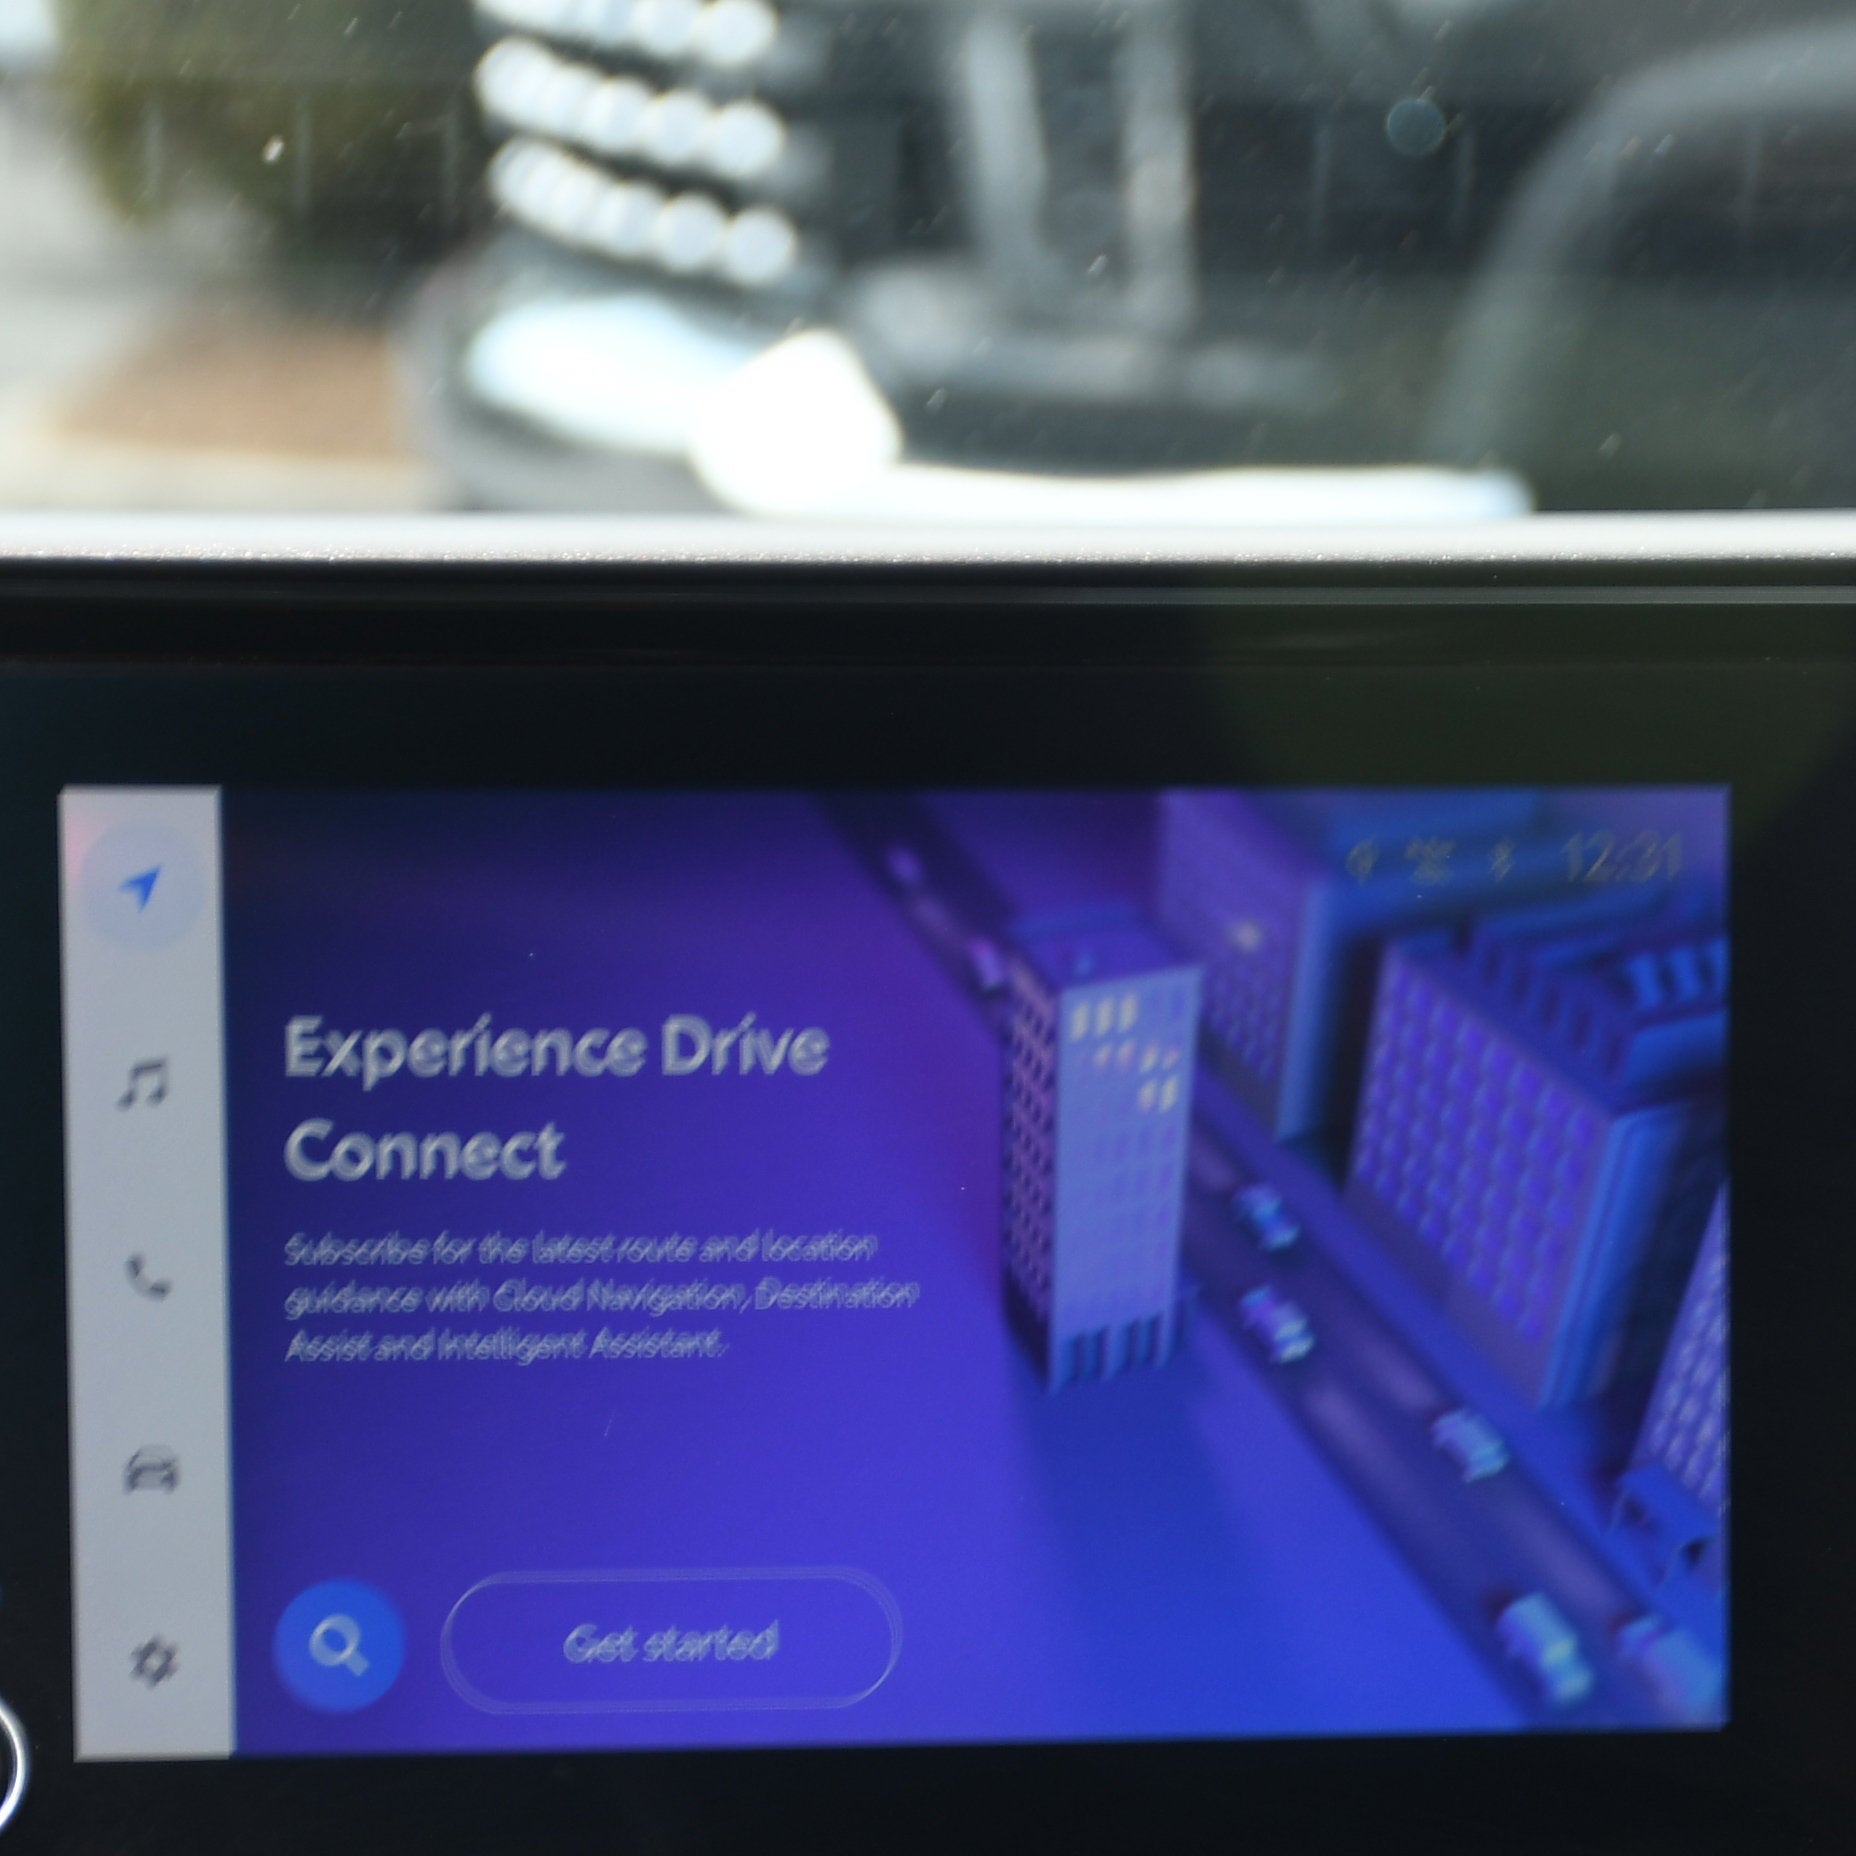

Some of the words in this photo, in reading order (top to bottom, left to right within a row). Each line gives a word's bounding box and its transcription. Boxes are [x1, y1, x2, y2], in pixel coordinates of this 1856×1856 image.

[284, 1011, 645, 1090] Experience
[662, 1011, 830, 1075] Drive
[284, 1117, 566, 1181] Connect
[284, 1231, 430, 1266] Subscribe
[432, 1229, 476, 1264] for
[478, 1229, 530, 1264] the
[531, 1229, 614, 1264] latest
[616, 1230, 698, 1263] route
[699, 1228, 760, 1262] and
[761, 1227, 879, 1262] location
[284, 1279, 423, 1321] guidance
[425, 1277, 490, 1314] with
[492, 1276, 584, 1313] Cloud
[754, 1275, 922, 1311] Destination
[284, 1328, 374, 1362] Assist
[375, 1326, 436, 1361] and
[438, 1325, 587, 1367] Intelligent
[562, 1622, 638, 1663] Get
[643, 1618, 781, 1662] started
